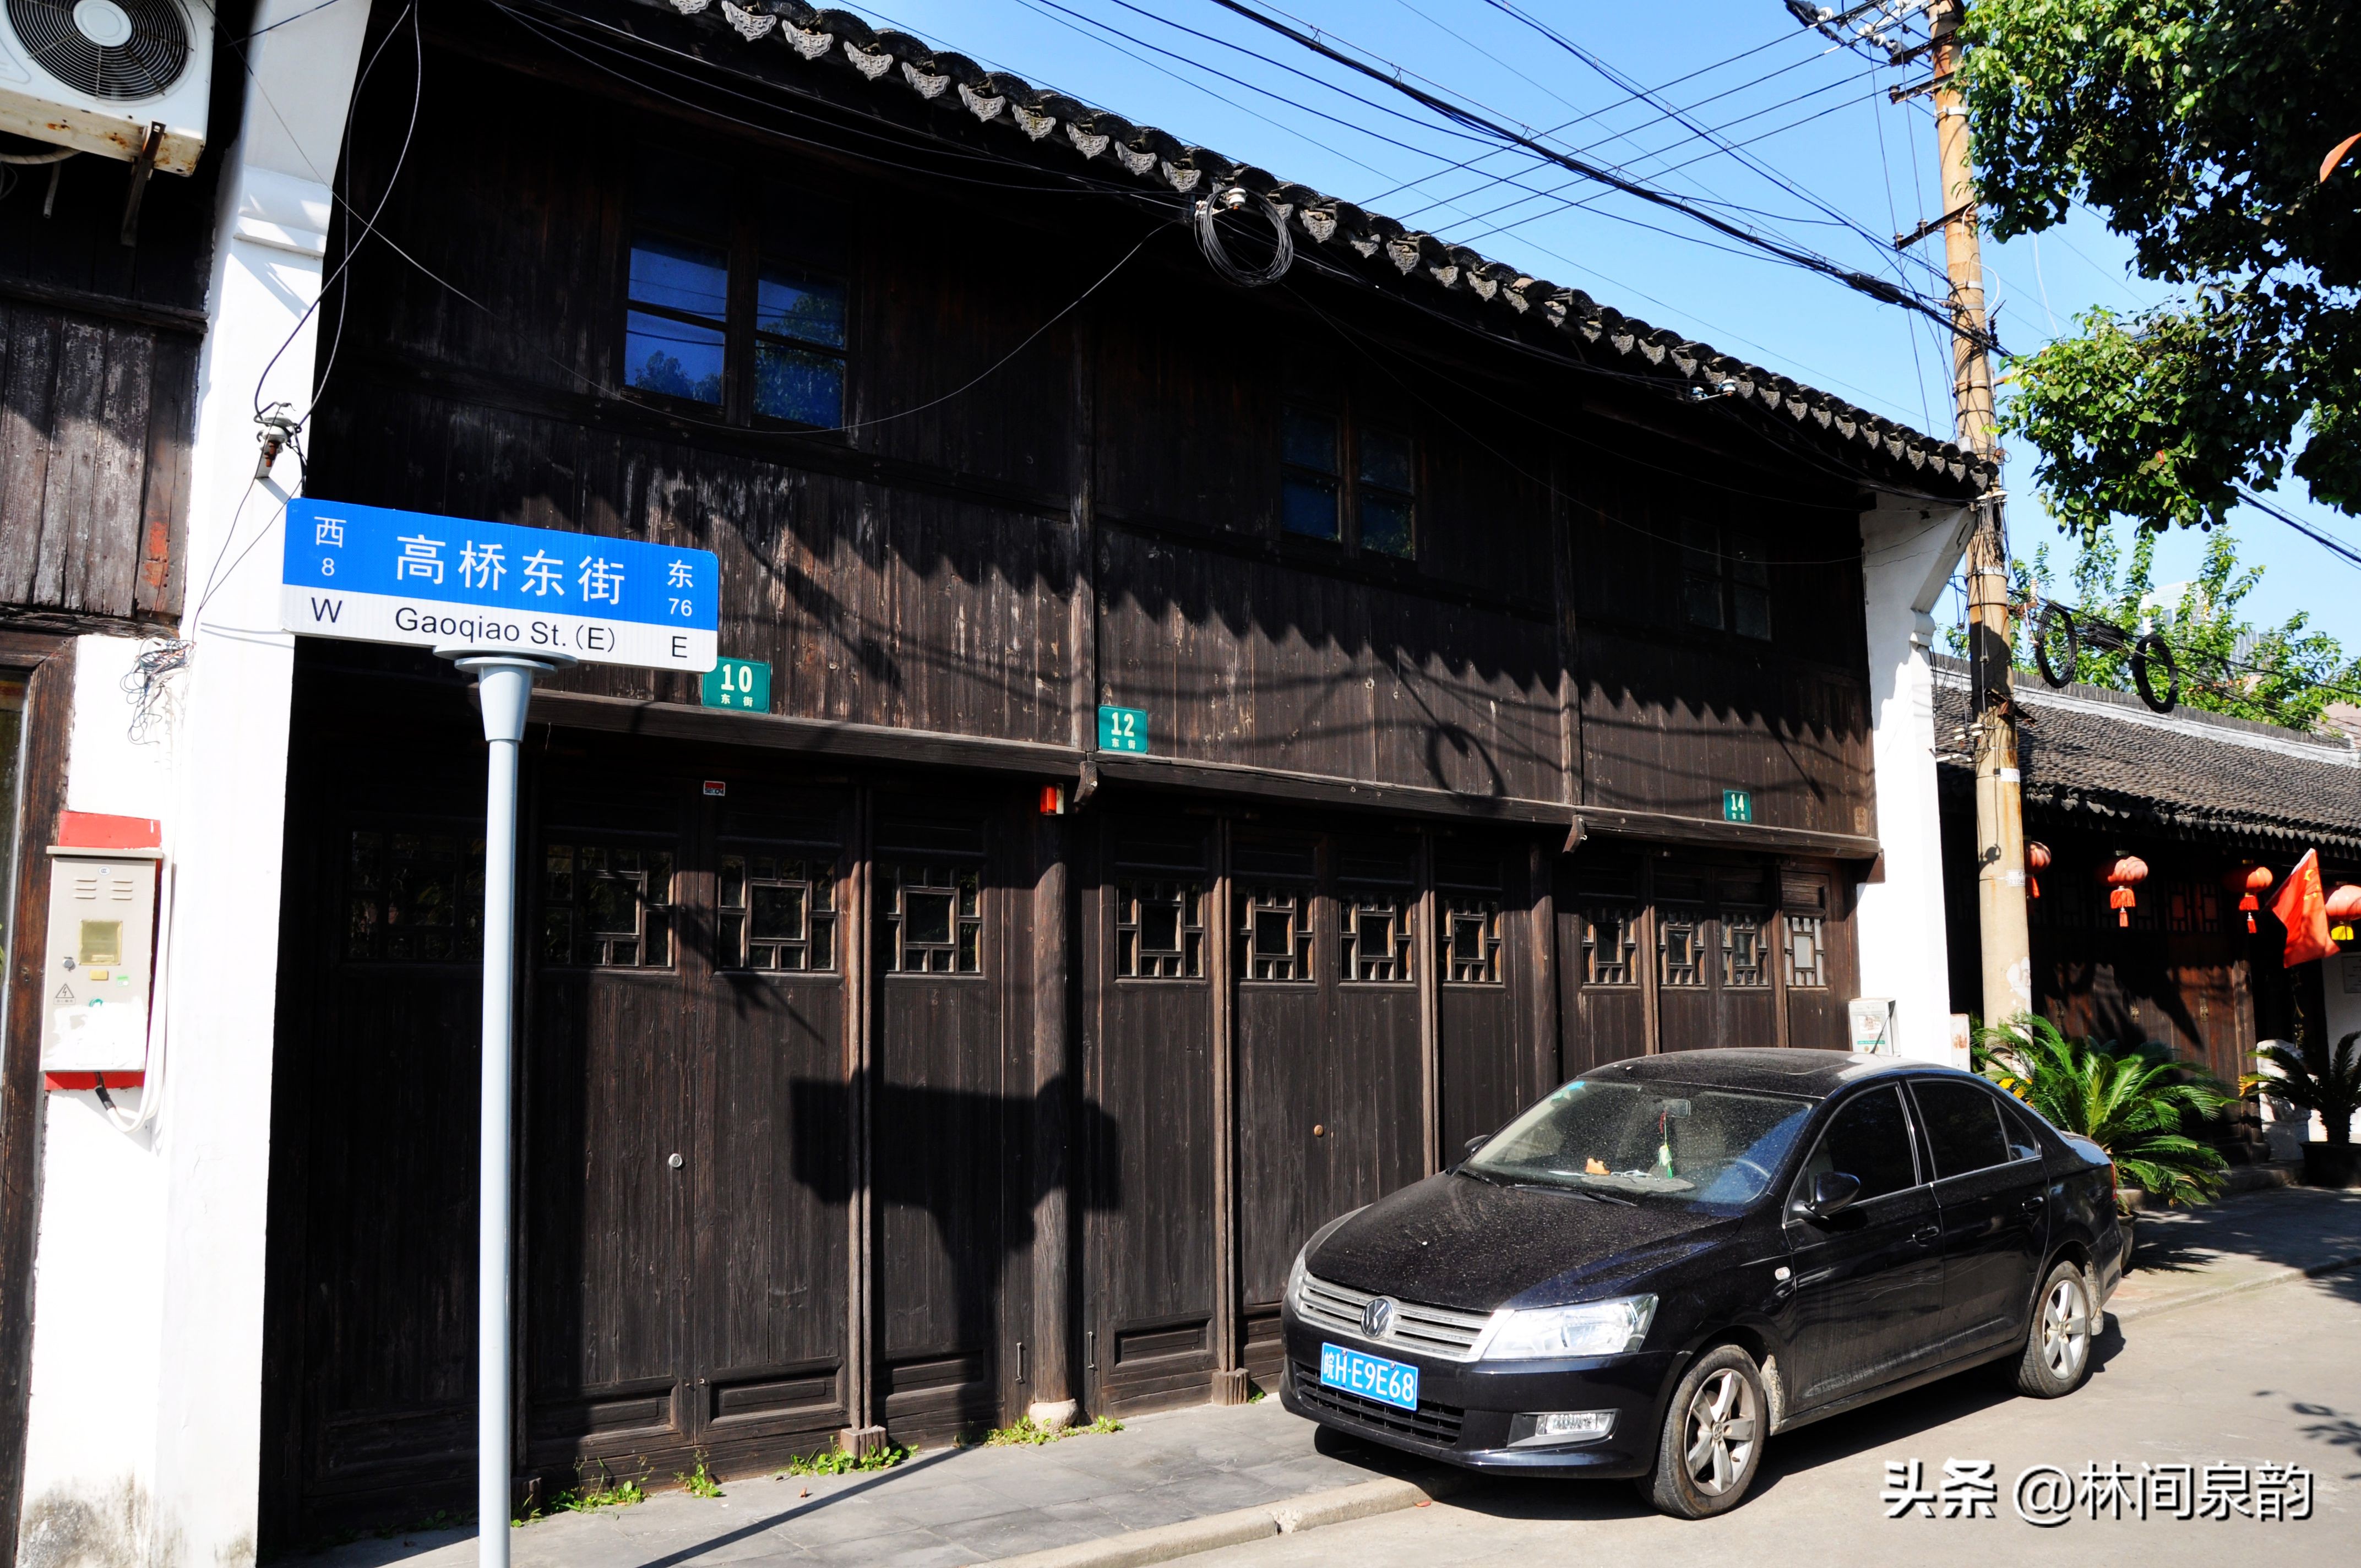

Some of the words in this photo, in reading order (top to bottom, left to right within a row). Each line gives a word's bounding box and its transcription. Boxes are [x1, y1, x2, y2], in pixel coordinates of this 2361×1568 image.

[314, 516, 347, 548] 西
[321, 557, 335, 576] 8
[396, 534, 625, 605] 高桥东街
[667, 559, 693, 588] 东
[311, 597, 342, 623] W
[668, 598, 693, 617] 76
[395, 607, 520, 644] Gaoqiao
[672, 636, 688, 658] E
[721, 664, 753, 693] 10
[721, 693, 753, 707] 东街
[1111, 712, 1134, 737] 12
[1731, 793, 1744, 812] 14
